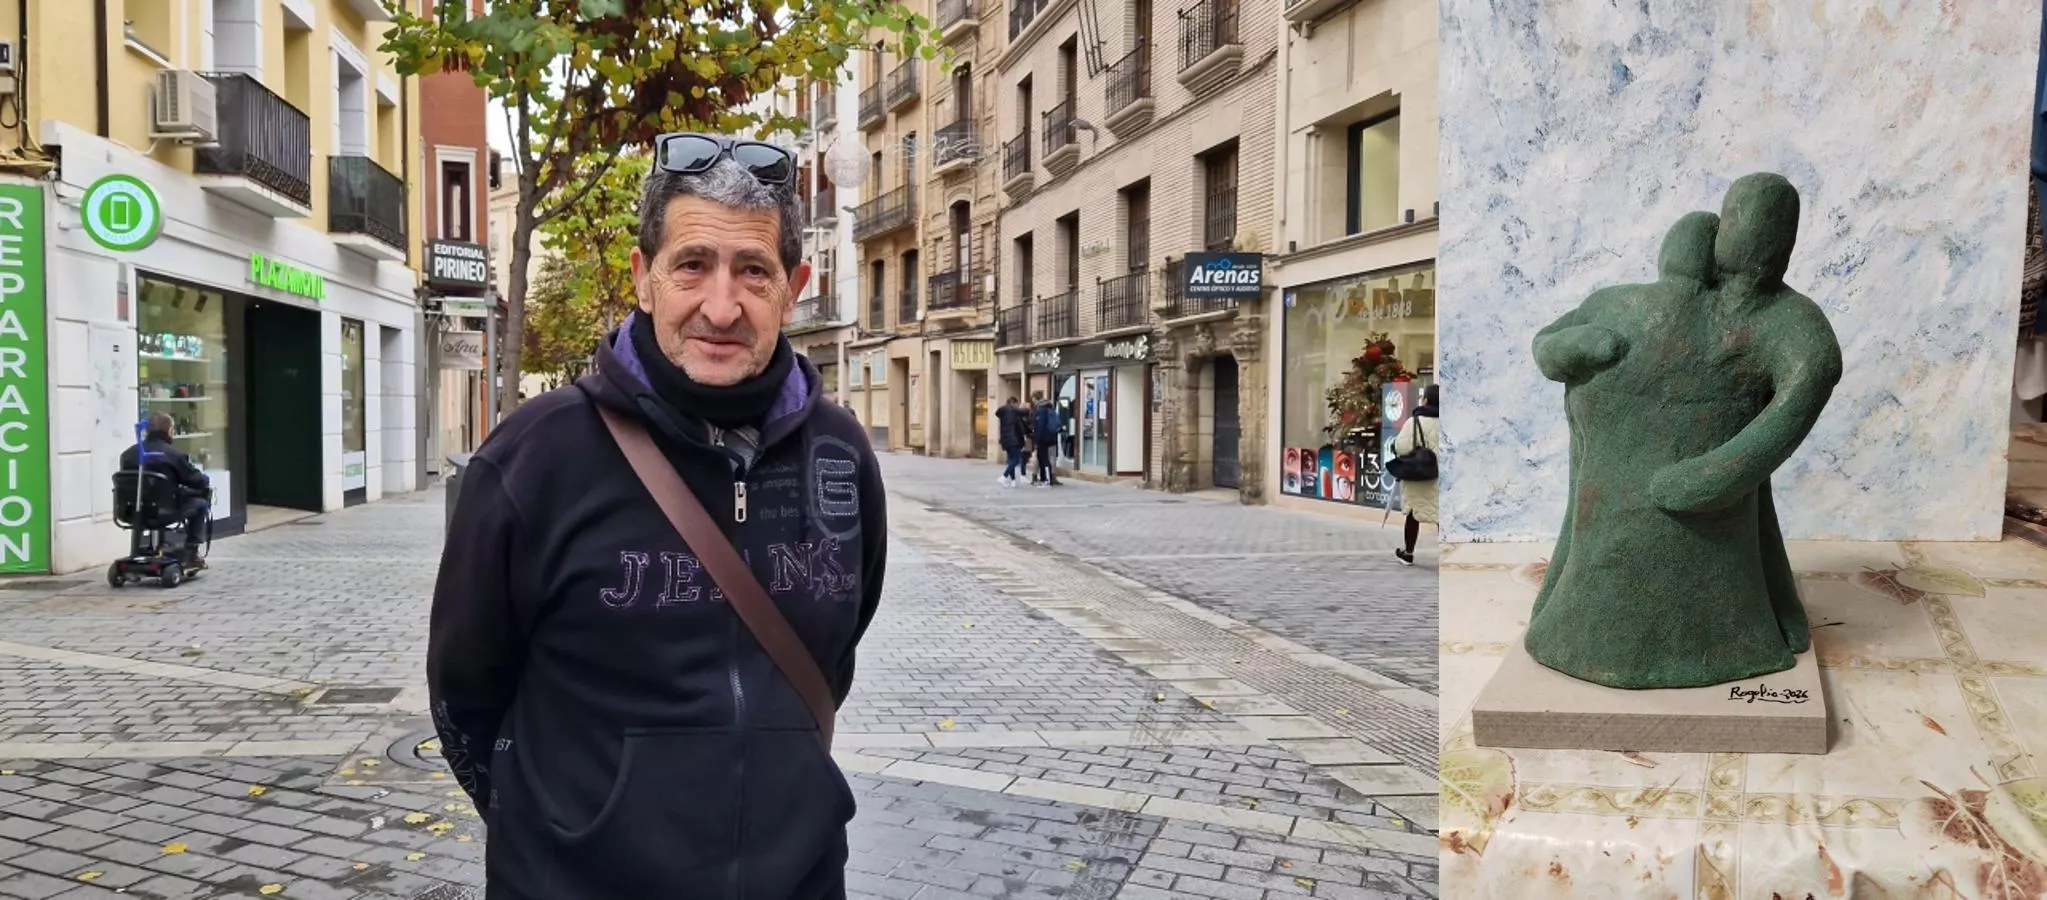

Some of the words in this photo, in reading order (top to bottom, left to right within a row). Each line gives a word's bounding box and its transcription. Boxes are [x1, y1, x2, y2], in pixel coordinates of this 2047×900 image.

[434, 243, 486, 259] EDITORIAL
[434, 256, 486, 282] PIRINEO
[1190, 264, 1260, 284] Arenas
[0, 195, 32, 564] REPARACION
[600, 535, 843, 609] JENS
